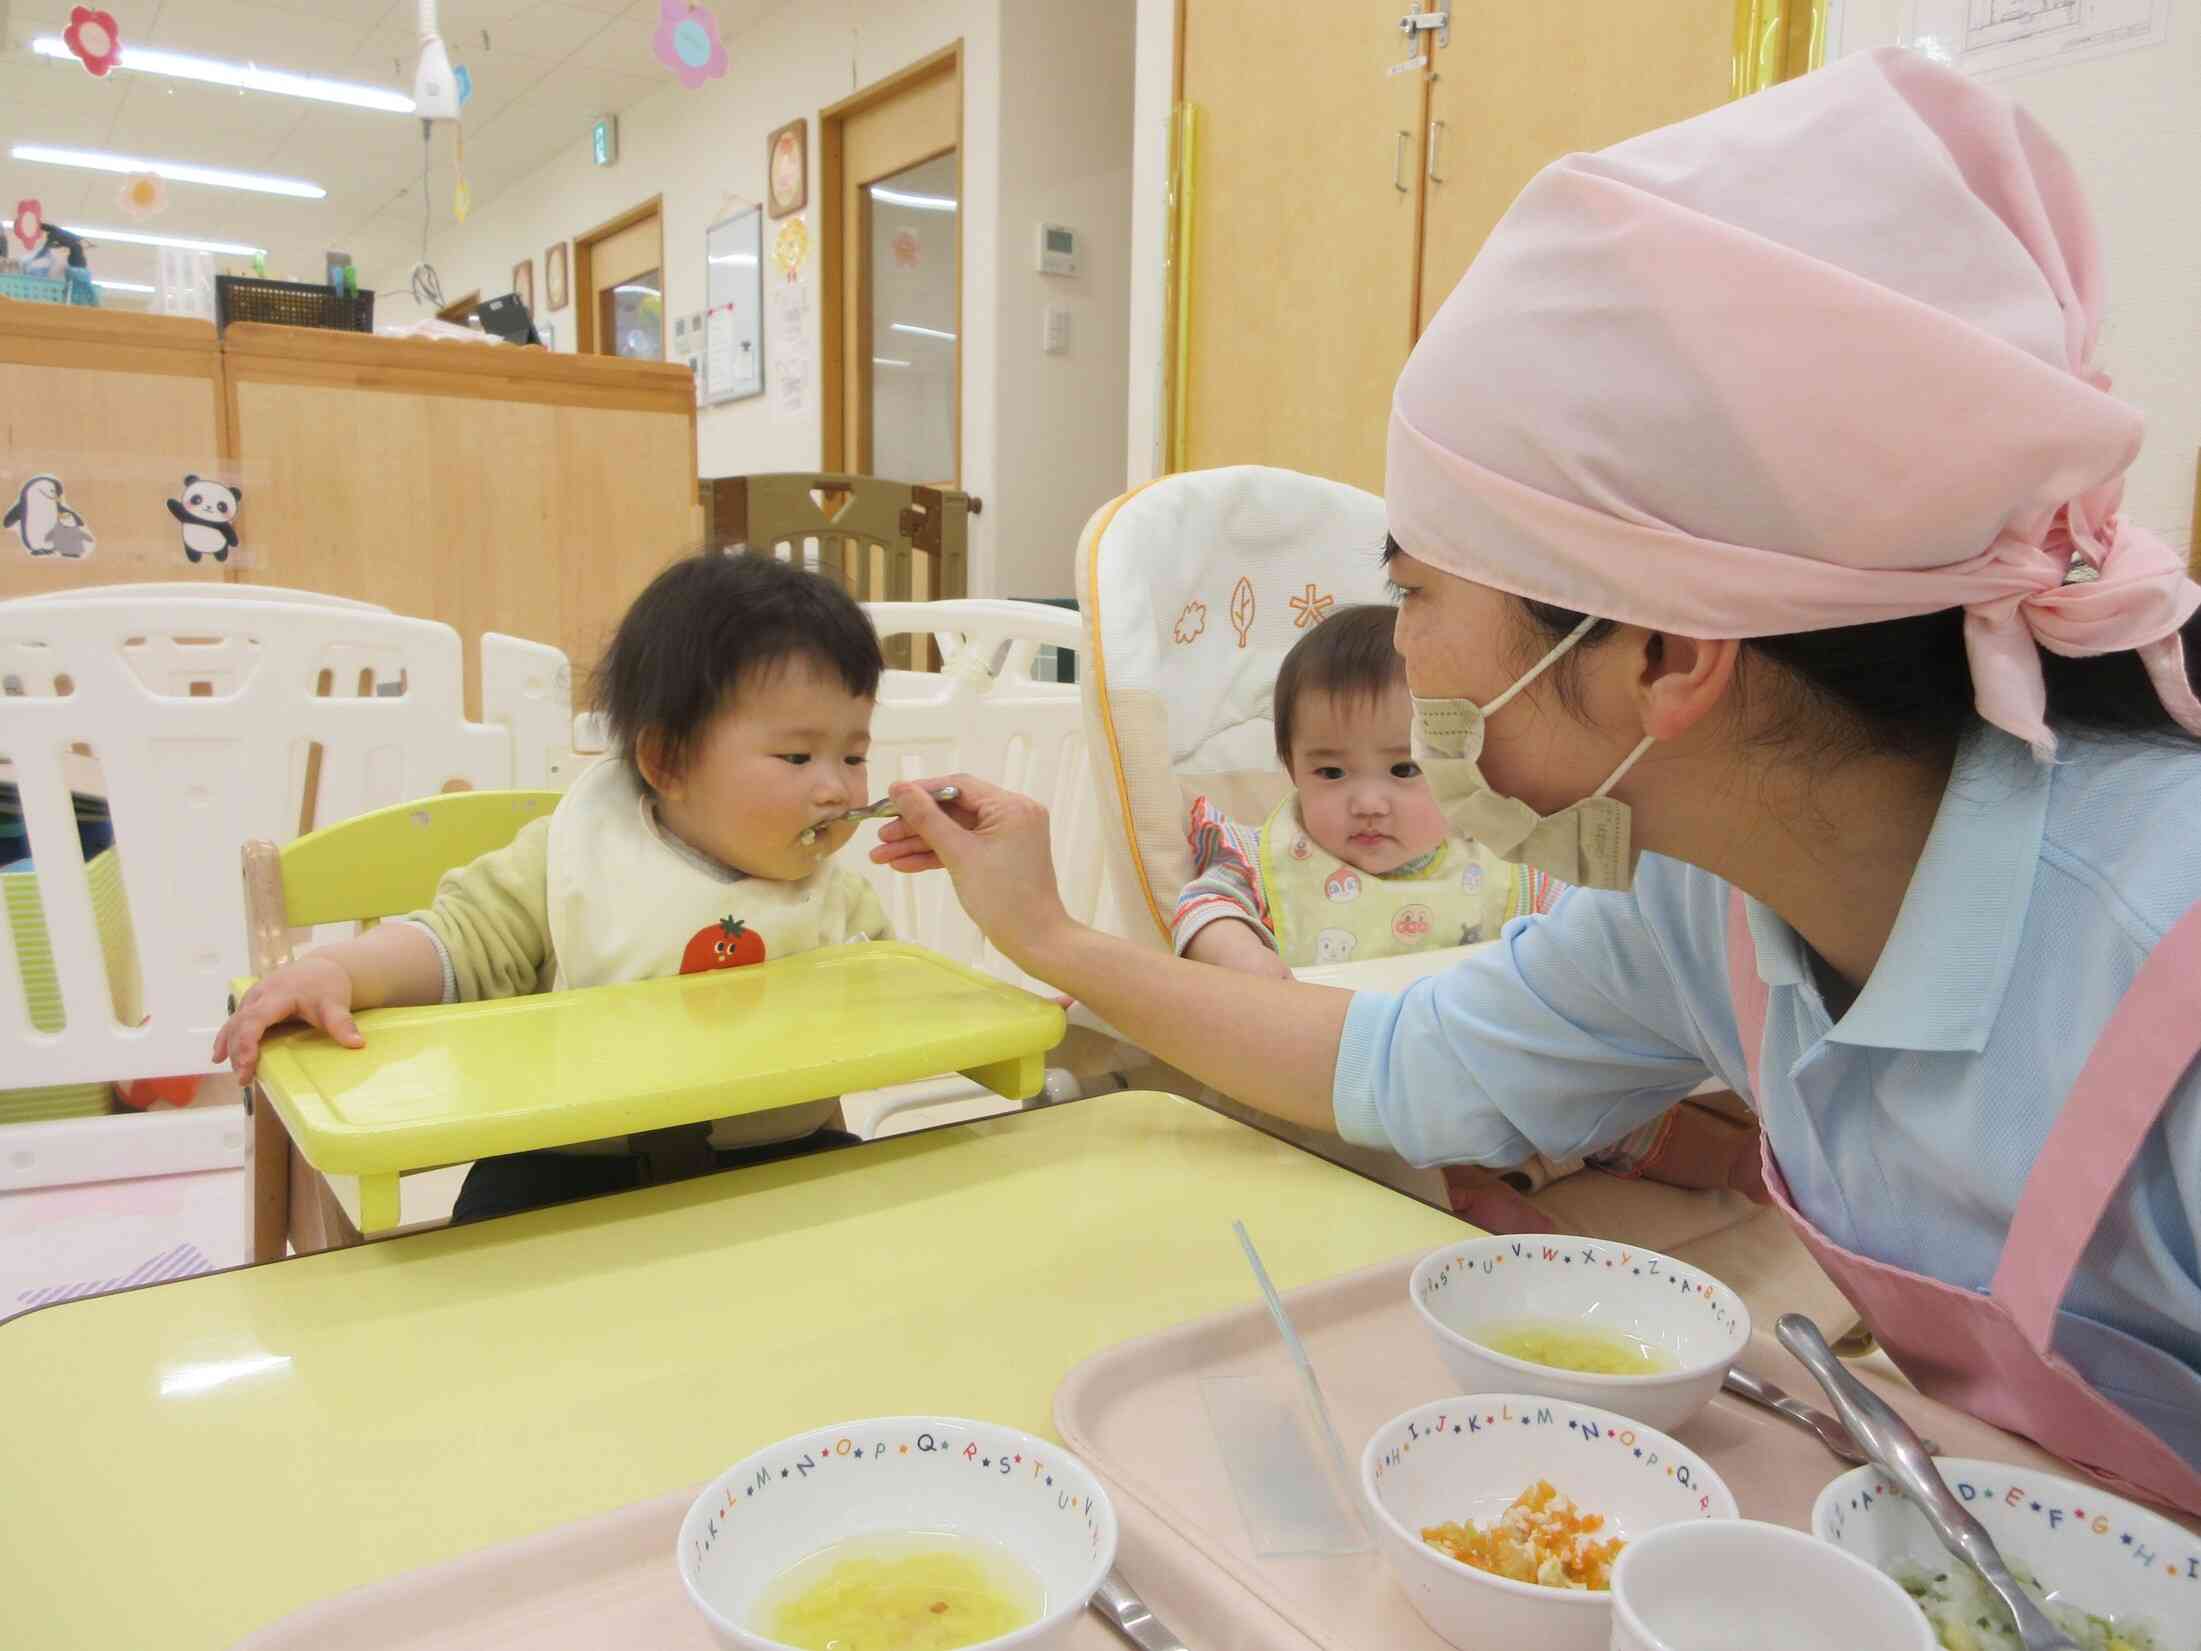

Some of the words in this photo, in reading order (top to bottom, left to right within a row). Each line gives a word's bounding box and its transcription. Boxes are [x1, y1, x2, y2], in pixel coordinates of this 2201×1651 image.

[1483, 1260, 1493, 1274] U
[1512, 1243, 1521, 1257] V
[1543, 1246, 1559, 1261] W
[1582, 1250, 1596, 1264] X
[1621, 1250, 1632, 1265] Y
[1648, 1260, 1660, 1274] Z
[1681, 1279, 1690, 1294] A
[726, 1487, 737, 1507] L
[756, 1466, 772, 1489] M
[796, 1454, 816, 1477] N
[836, 1438, 853, 1456] O
[875, 1442, 887, 1460] P
[917, 1433, 937, 1452] Q
[962, 1442, 977, 1461] R
[999, 1456, 1011, 1474] S
[1033, 1459, 1044, 1478] T
[1057, 1490, 1069, 1510] U
[1408, 1423, 1418, 1440] I
[1435, 1415, 1447, 1432] J
[1468, 1415, 1481, 1432] K
[1503, 1404, 1512, 1420] L
[1537, 1408, 1553, 1424] M
[1582, 1422, 1599, 1441] N
[1620, 1431, 1635, 1446] O
[1646, 1453, 1658, 1466] P
[1677, 1466, 1690, 1488] Q
[1699, 1495, 1709, 1511] R
[1861, 1490, 1873, 1511] A
[1958, 1483, 1975, 1501] D
[2005, 1486, 2025, 1507] E
[2049, 1508, 2063, 1529] F
[2091, 1515, 2109, 1535] G
[2133, 1544, 2155, 1567] H
[2187, 1557, 2199, 1579] I
